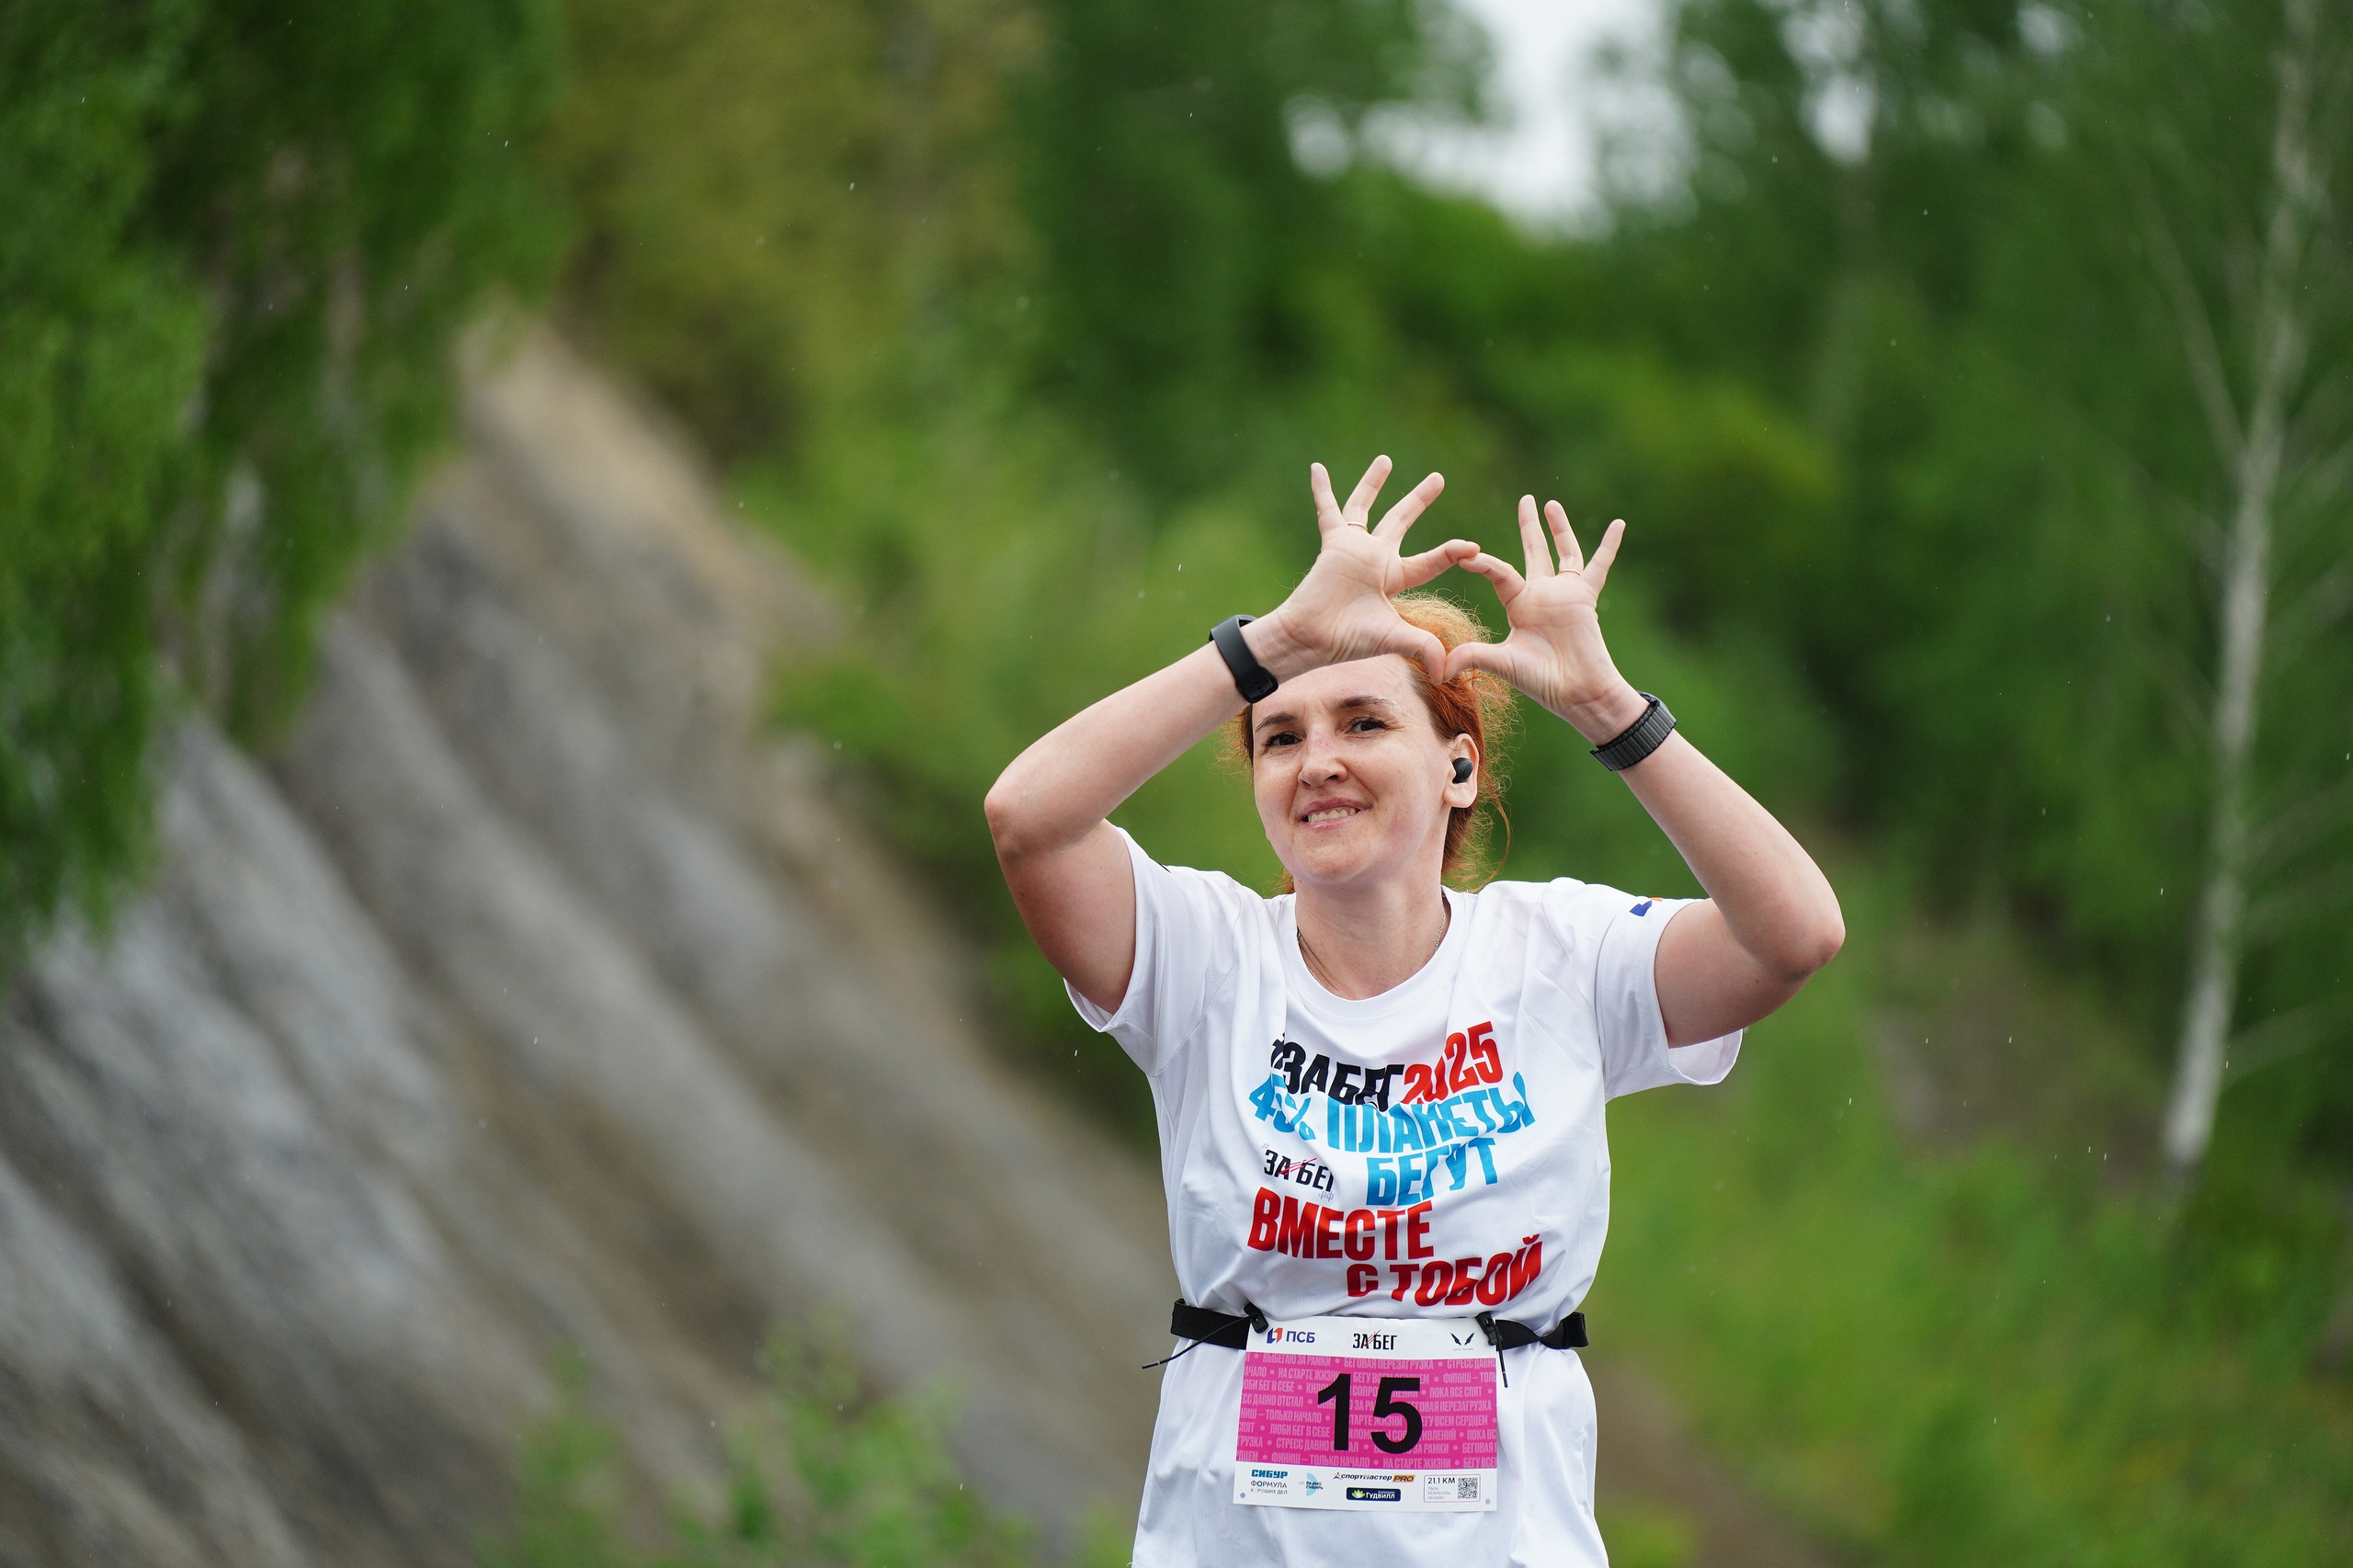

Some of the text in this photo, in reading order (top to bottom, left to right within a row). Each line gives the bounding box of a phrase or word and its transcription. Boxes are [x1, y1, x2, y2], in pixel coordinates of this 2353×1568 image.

[1327, 1071, 1536, 1153] ПЛАНЕТЫ
[1366, 1137, 1498, 1206] БЕГУТ
[1247, 1187, 1434, 1260] ВМЕСТЕ
[1347, 1233, 1543, 1307] С ТОБОЙ
[1286, 1330, 1316, 1344] ПСБ
[1279, 1368, 1287, 1379] НА
[1289, 1369, 1313, 1381] СТАРТЕ
[1353, 1371, 1370, 1383] БЕГУ
[1443, 1372, 1472, 1383] ФИНИШ
[1258, 1380, 1271, 1391] БЕГ
[1272, 1381, 1278, 1392] В
[1278, 1381, 1295, 1392] СЕБЕ
[1429, 1387, 1449, 1399] ПОКА
[1449, 1386, 1463, 1398] ВСЕ
[1464, 1386, 1483, 1398] СПЯТ
[1253, 1394, 1276, 1406] ДАВНО
[1277, 1395, 1304, 1407] ОТСТАЛ
[1439, 1400, 1492, 1413] ПЕРЕЗАГРУЗКА
[1265, 1409, 1293, 1422] ТОЛЬКО
[1293, 1411, 1323, 1424] НАЧАЛО
[1435, 1415, 1455, 1427] ВСЕМ
[1455, 1415, 1488, 1427] СЕРДЦЕМ
[1317, 1373, 1423, 1454] 15
[1270, 1423, 1291, 1436] ЛЮБИ
[1292, 1425, 1305, 1437] БЕГ
[1306, 1426, 1312, 1437] В
[1312, 1426, 1331, 1438] СЕБЕ
[1467, 1428, 1486, 1441] ПОКА
[1276, 1437, 1304, 1450] СТРЕСС
[1304, 1438, 1329, 1451] ДАВНО
[1424, 1443, 1449, 1455] РАМКИ
[1462, 1442, 1495, 1454] БЕГОВАЯ
[1271, 1451, 1301, 1464] ФИНИШ
[1310, 1454, 1339, 1467] ТОЛЬКО
[1339, 1456, 1370, 1468] НАЧАЛО
[1383, 1458, 1393, 1469] НА
[1394, 1458, 1423, 1470] СТАРТЕ
[1424, 1458, 1451, 1469] ЖИЗНИ
[1251, 1469, 1288, 1479] СИБУР
[1251, 1480, 1288, 1488] ФОРМУЛА
